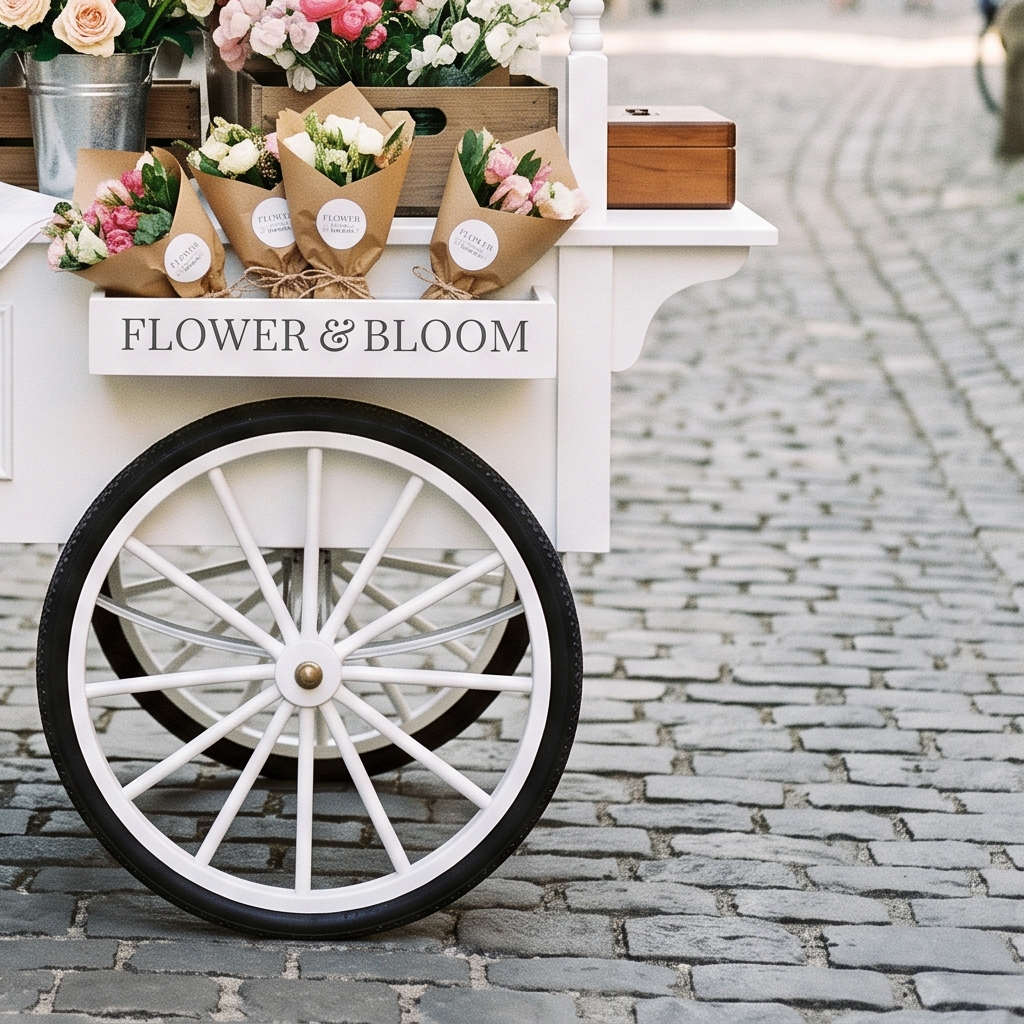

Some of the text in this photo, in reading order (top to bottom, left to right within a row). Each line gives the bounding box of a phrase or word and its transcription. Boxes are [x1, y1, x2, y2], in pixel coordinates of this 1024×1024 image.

[323, 215, 360, 223] FLOWER
[122, 318, 529, 353] FLOWER & BLOOM
